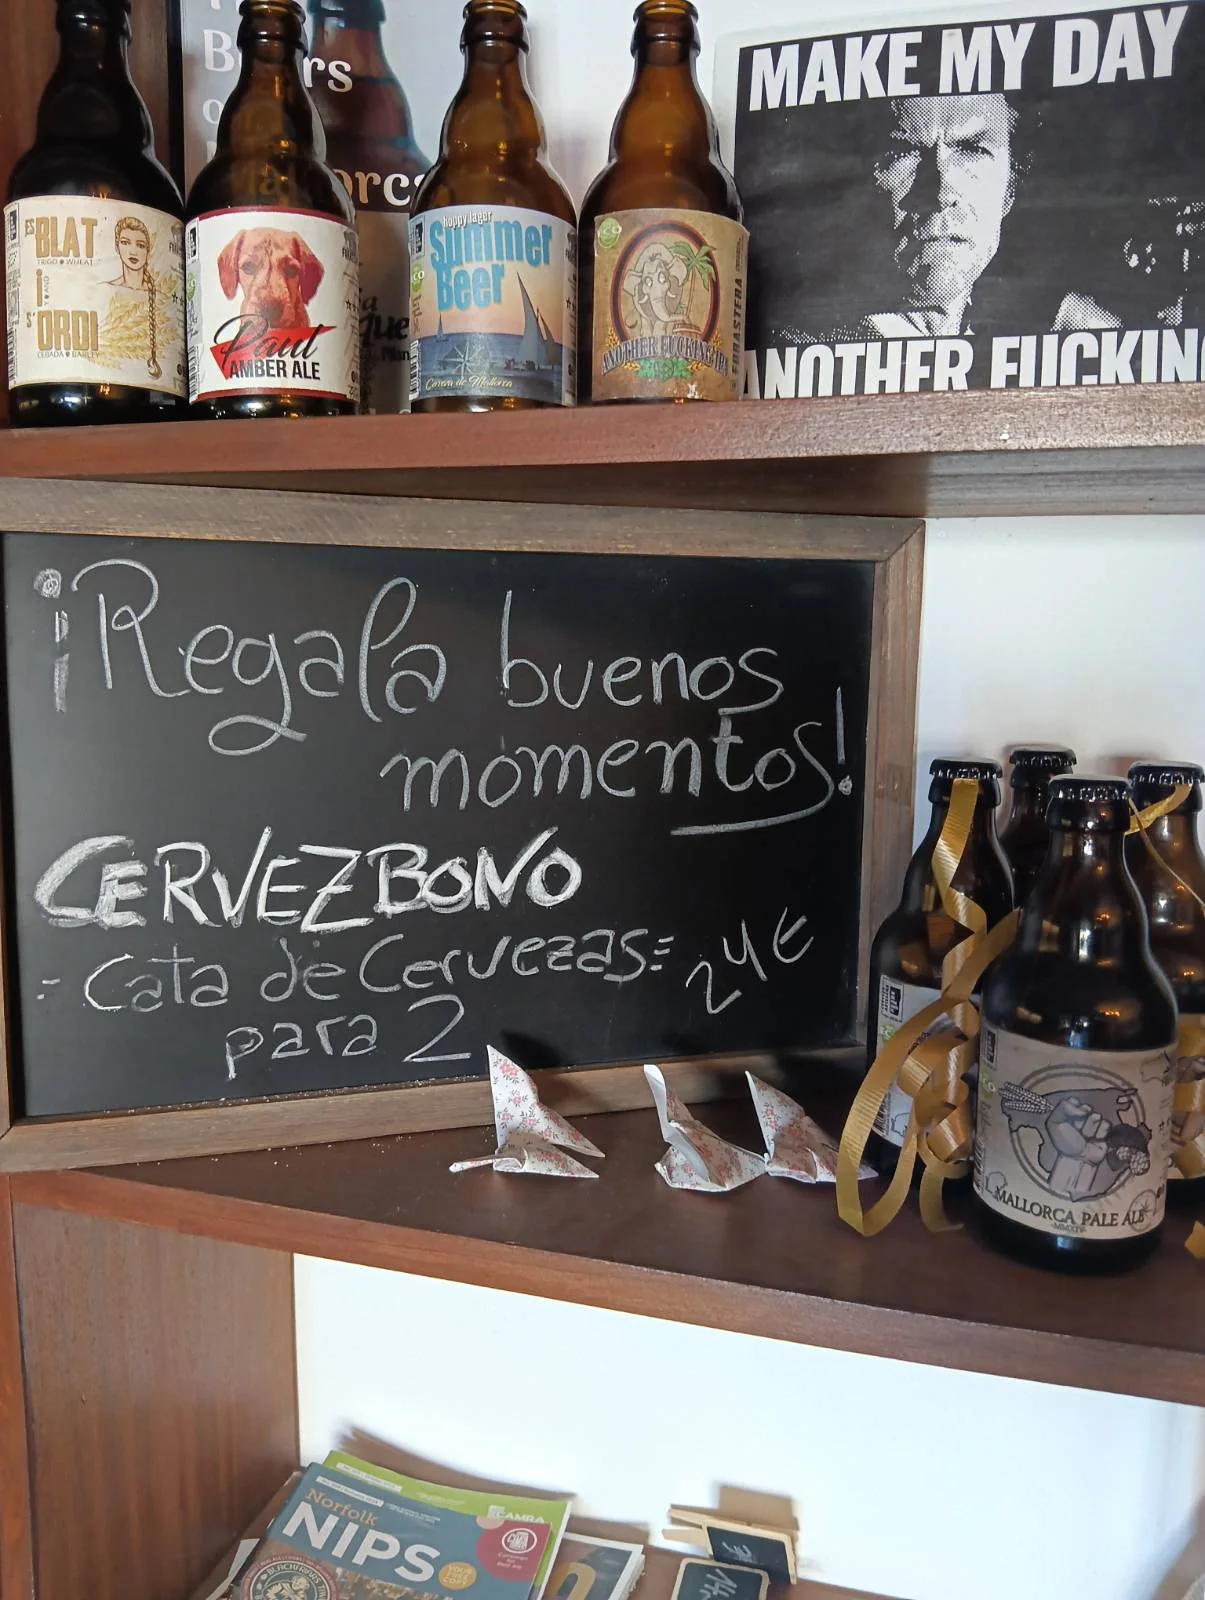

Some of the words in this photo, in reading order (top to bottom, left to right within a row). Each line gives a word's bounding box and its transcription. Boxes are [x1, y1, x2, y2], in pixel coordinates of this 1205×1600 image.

[749, 32, 923, 112] MAKE
[938, 22, 1036, 95] MY
[1052, 5, 1190, 88] DAY
[35, 217, 98, 258] BLAT
[429, 220, 552, 268] Summer
[443, 214, 470, 230] hoppy
[469, 210, 493, 226] lager
[435, 262, 505, 312] Beer
[229, 359, 287, 379] AMBER
[292, 360, 321, 380] ALE
[601, 335, 656, 377] ANOTHER
[660, 335, 713, 367] FUCKING
[990, 328, 1205, 388] FUCKIN
[500, 590, 784, 713] buenos
[83, 943, 231, 1014] Cata
[259, 936, 347, 1003] de
[224, 1013, 378, 1082] para
[403, 993, 473, 1064] 2
[994, 1185, 1076, 1226] MALLORCA
[1080, 1211, 1120, 1228] PALE
[1122, 1209, 1146, 1227] ALE
[305, 1487, 379, 1526] Norfolk
[281, 1501, 441, 1583] NIPS
